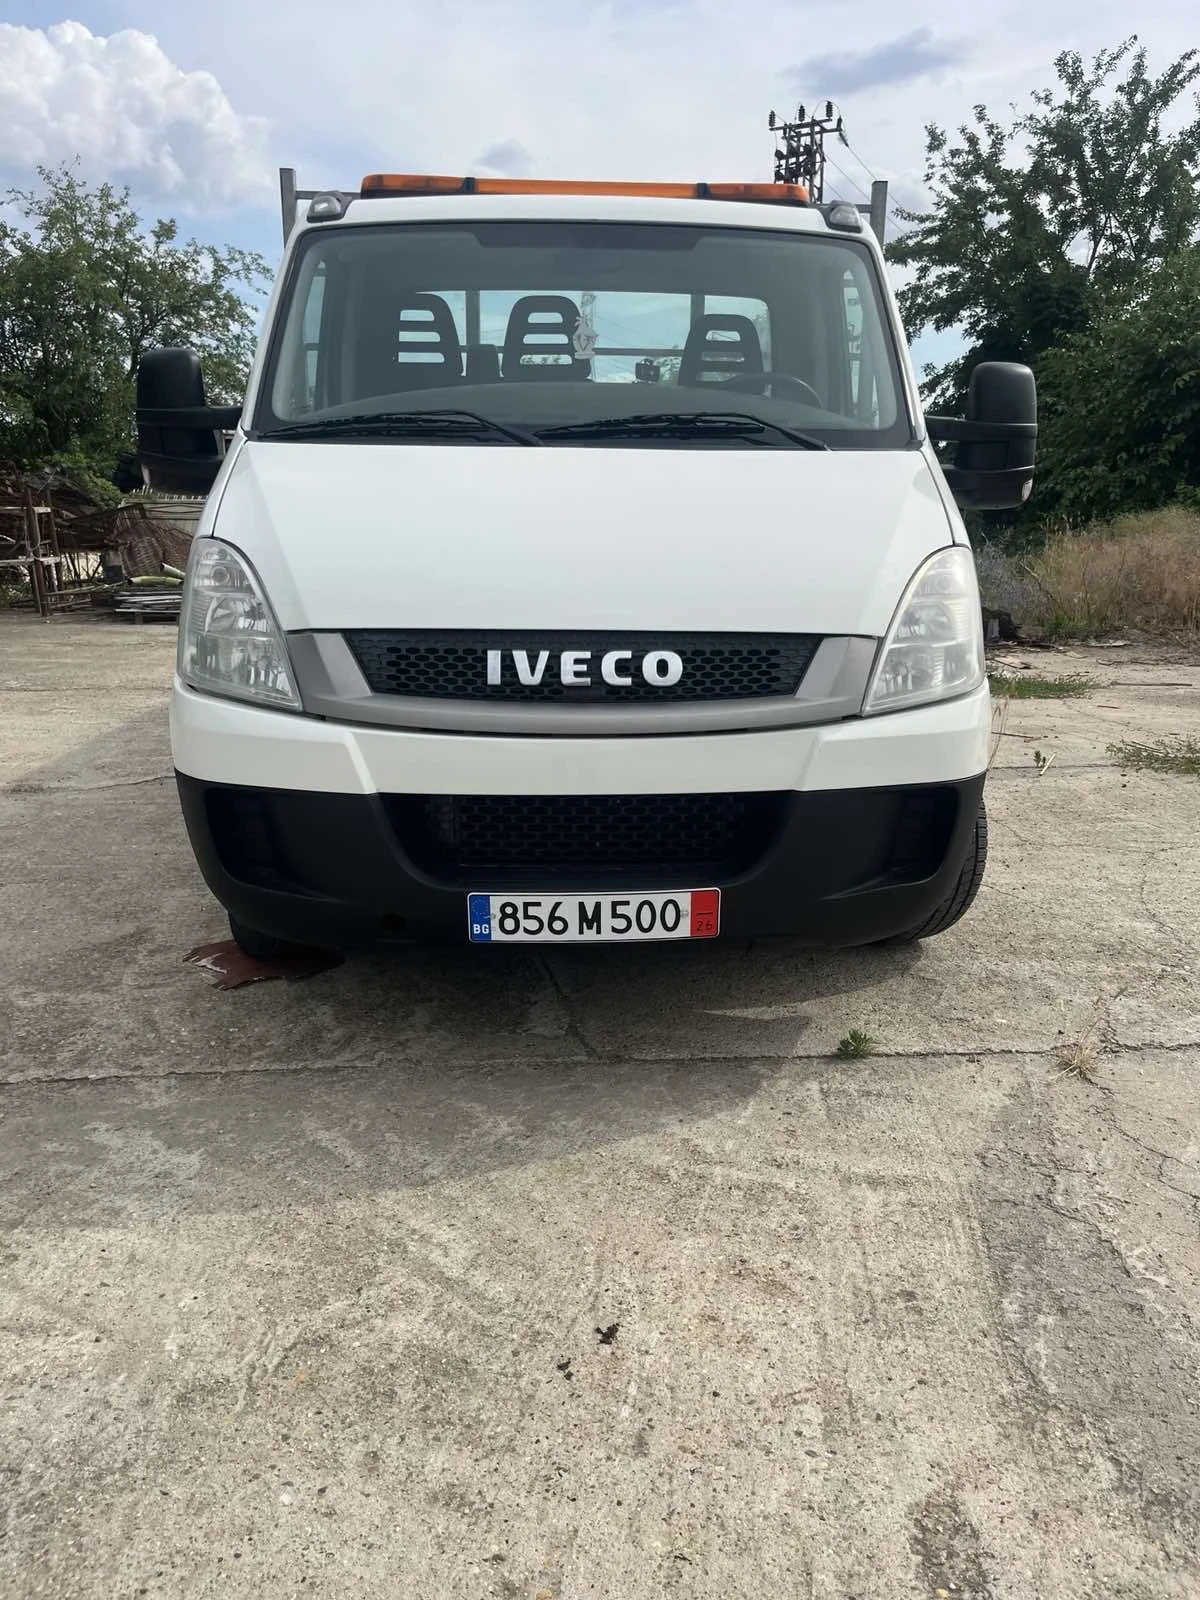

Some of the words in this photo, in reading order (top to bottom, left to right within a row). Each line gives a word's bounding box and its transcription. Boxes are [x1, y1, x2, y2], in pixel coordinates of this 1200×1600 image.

[487, 650, 683, 686] IVECO
[473, 924, 490, 934] BG
[498, 901, 569, 935] 856
[578, 901, 602, 935] M
[611, 899, 681, 934] 500
